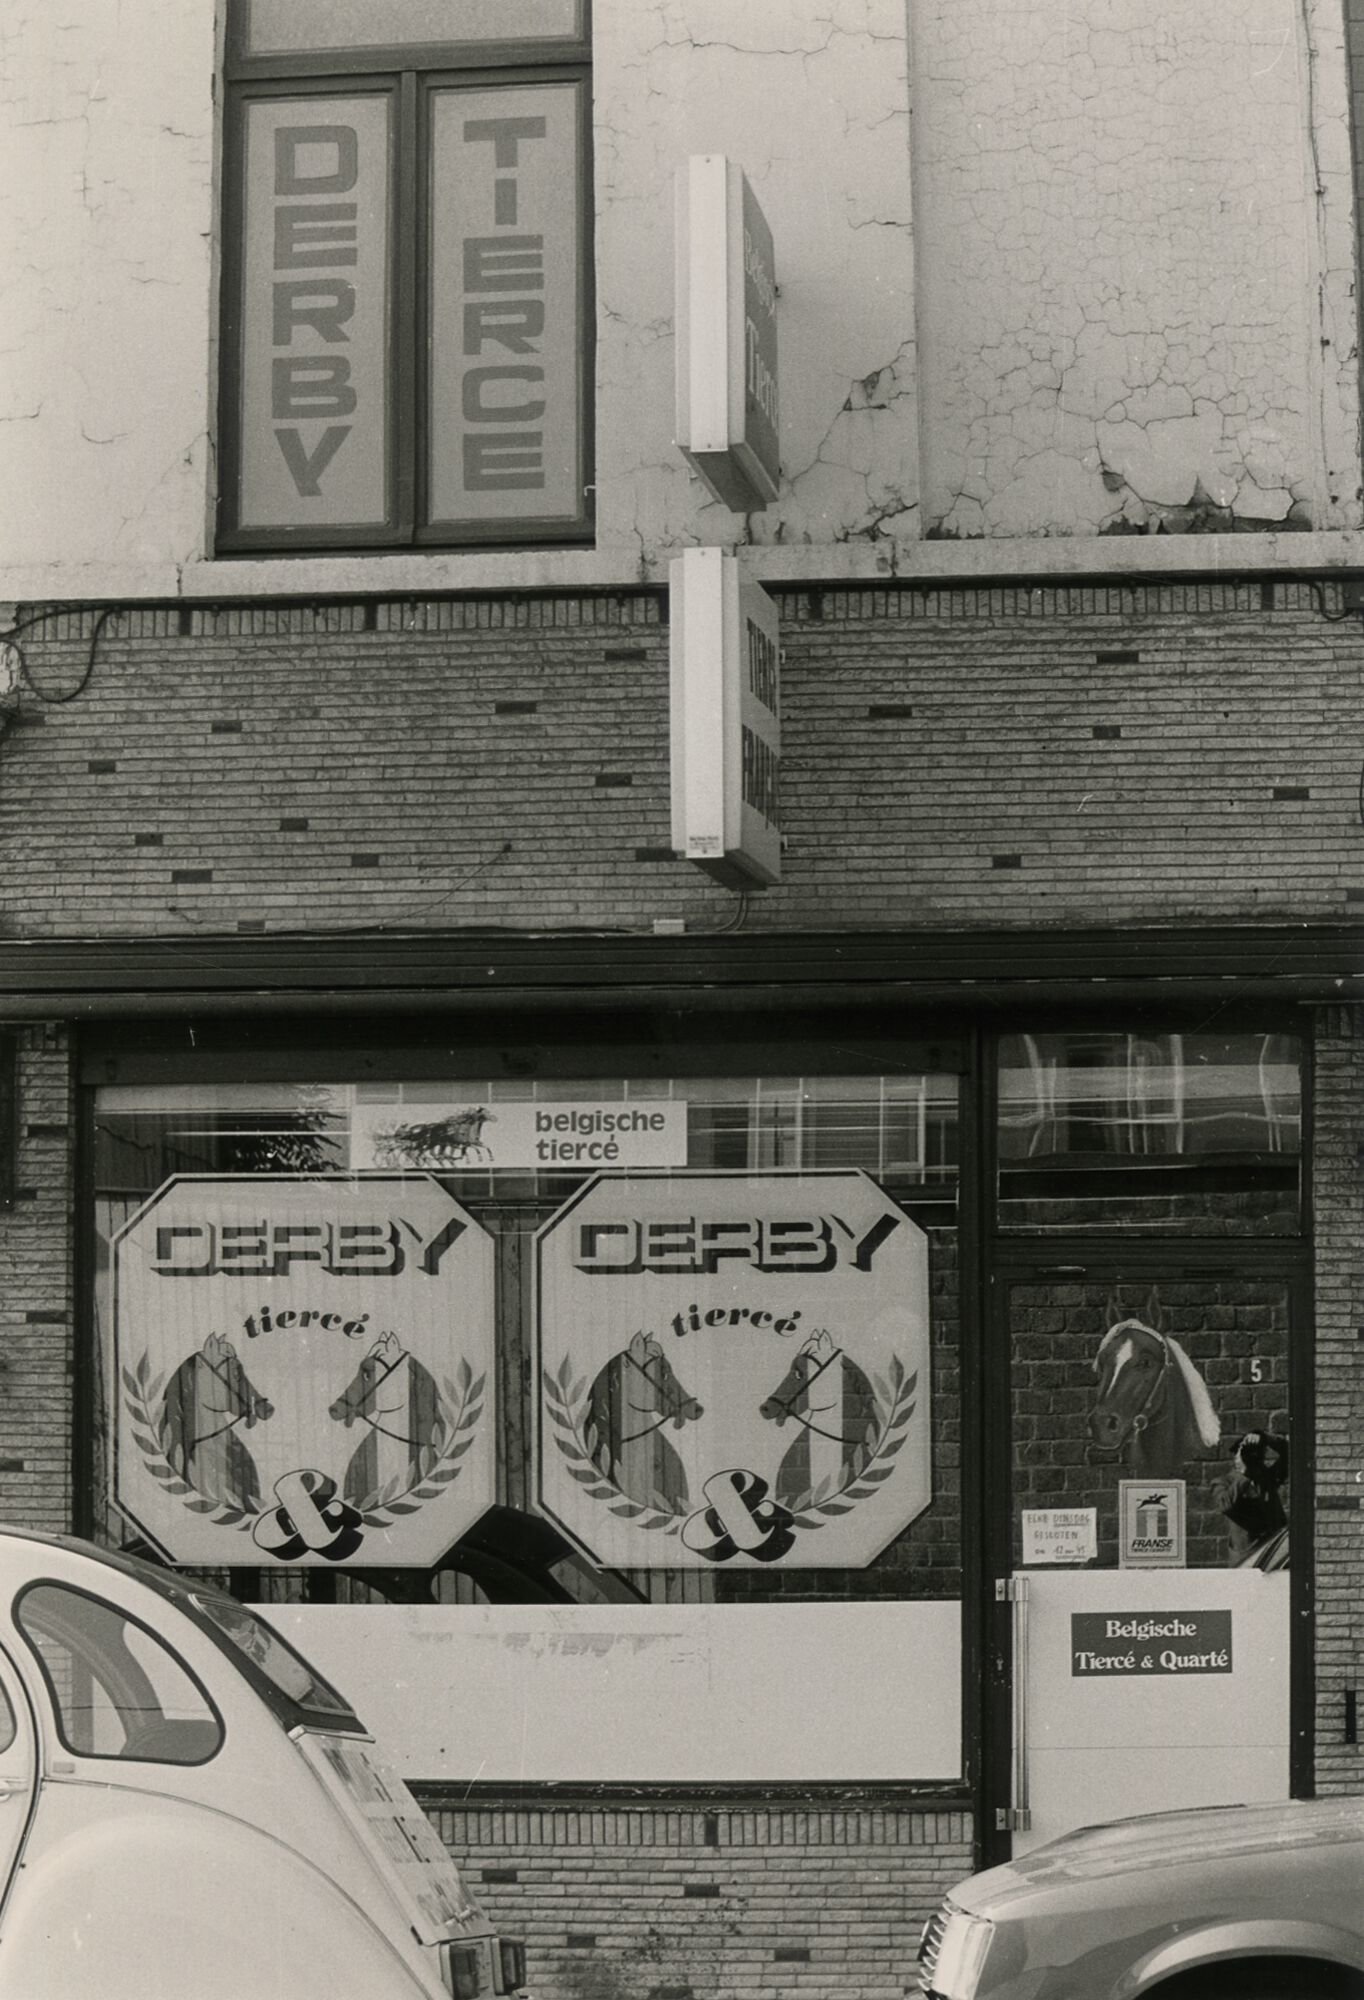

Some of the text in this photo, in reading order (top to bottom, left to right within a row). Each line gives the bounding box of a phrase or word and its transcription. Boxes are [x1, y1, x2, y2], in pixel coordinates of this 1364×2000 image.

[271, 124, 359, 497] DERBY
[462, 115, 546, 491] TIERCE
[536, 1110, 665, 1135] belgische
[536, 1134, 619, 1160] tiercé
[150, 1217, 468, 1276] DERBY
[572, 1213, 900, 1275] DERBY
[243, 1306, 370, 1339] tiercé
[671, 1303, 802, 1337] tiercé
[1251, 1359, 1262, 1382] 5
[252, 1469, 364, 1562] &
[680, 1469, 797, 1562] &
[1132, 1539, 1174, 1548] FRANSE
[1105, 1619, 1197, 1641] Belgische
[1075, 1649, 1228, 1670] Tiercé & Quarté
